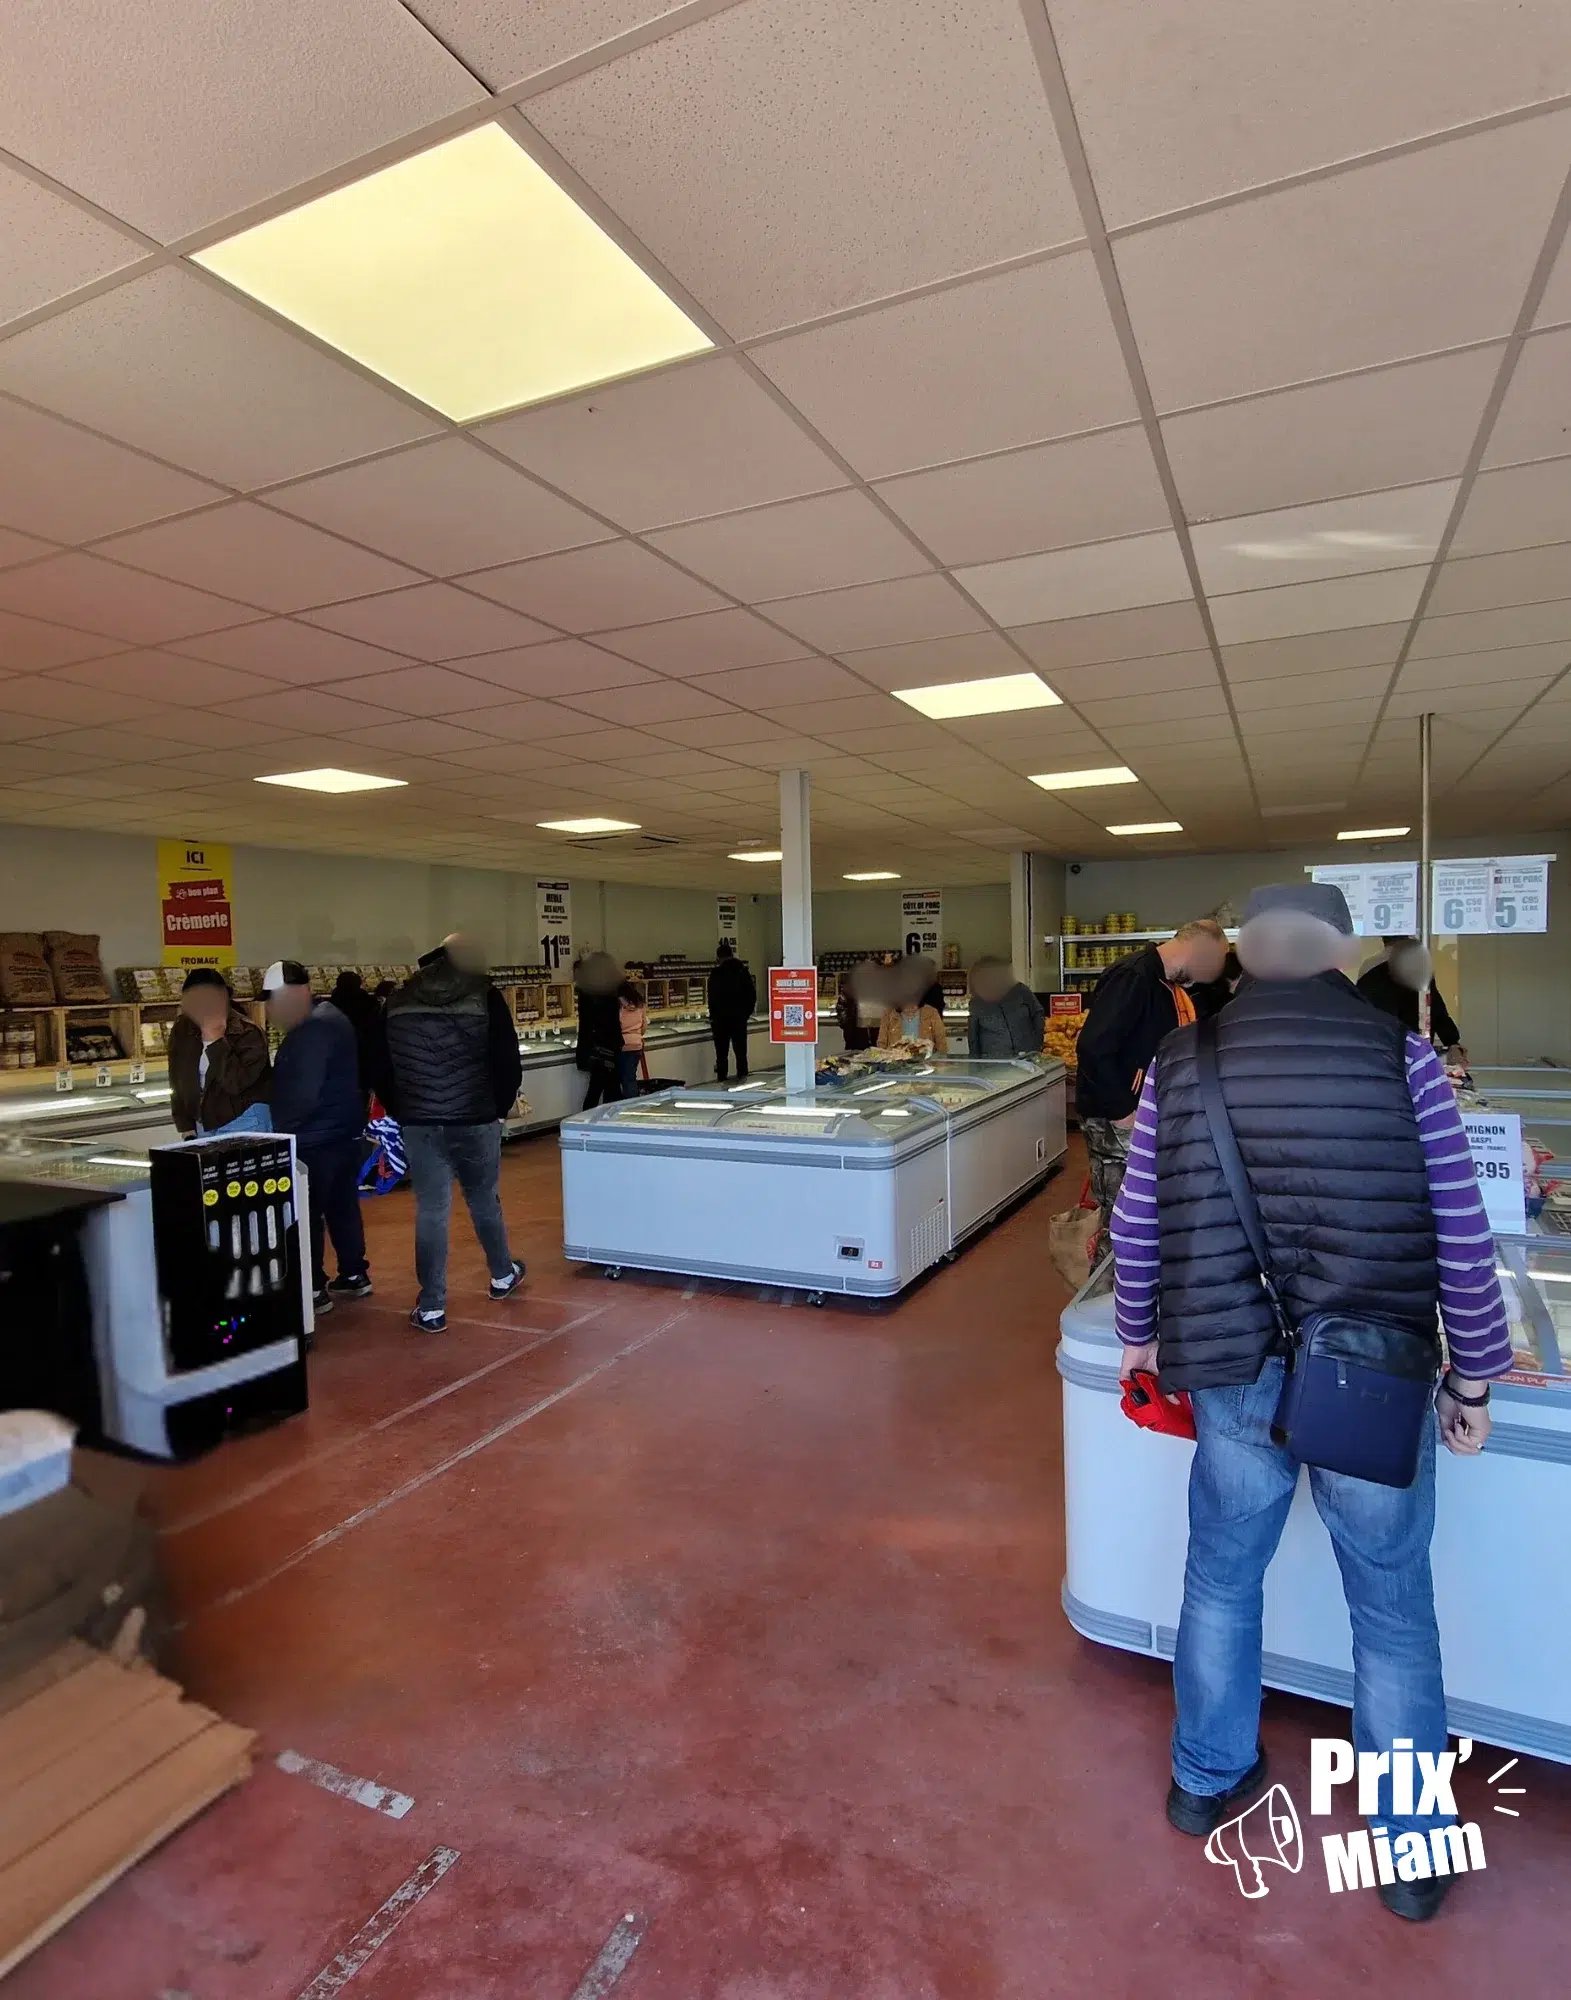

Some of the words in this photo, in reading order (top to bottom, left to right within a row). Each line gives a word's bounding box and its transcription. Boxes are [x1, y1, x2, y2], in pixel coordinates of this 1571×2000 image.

[186, 851, 204, 864] ICI
[1523, 874, 1543, 883] PORC
[188, 887, 202, 897] bon
[203, 886, 219, 896] plan
[544, 905, 552, 913] DES
[553, 905, 565, 914] ALPES
[925, 901, 940, 909] PORC
[1374, 904, 1391, 930] 9
[1443, 898, 1464, 929] 6
[1495, 896, 1517, 928] 5
[166, 912, 228, 931] Crèmerie
[906, 932, 921, 955] 6
[541, 935, 559, 968] 11
[181, 957, 219, 965] FROMAGE
[1465, 1125, 1506, 1135] MIGNON
